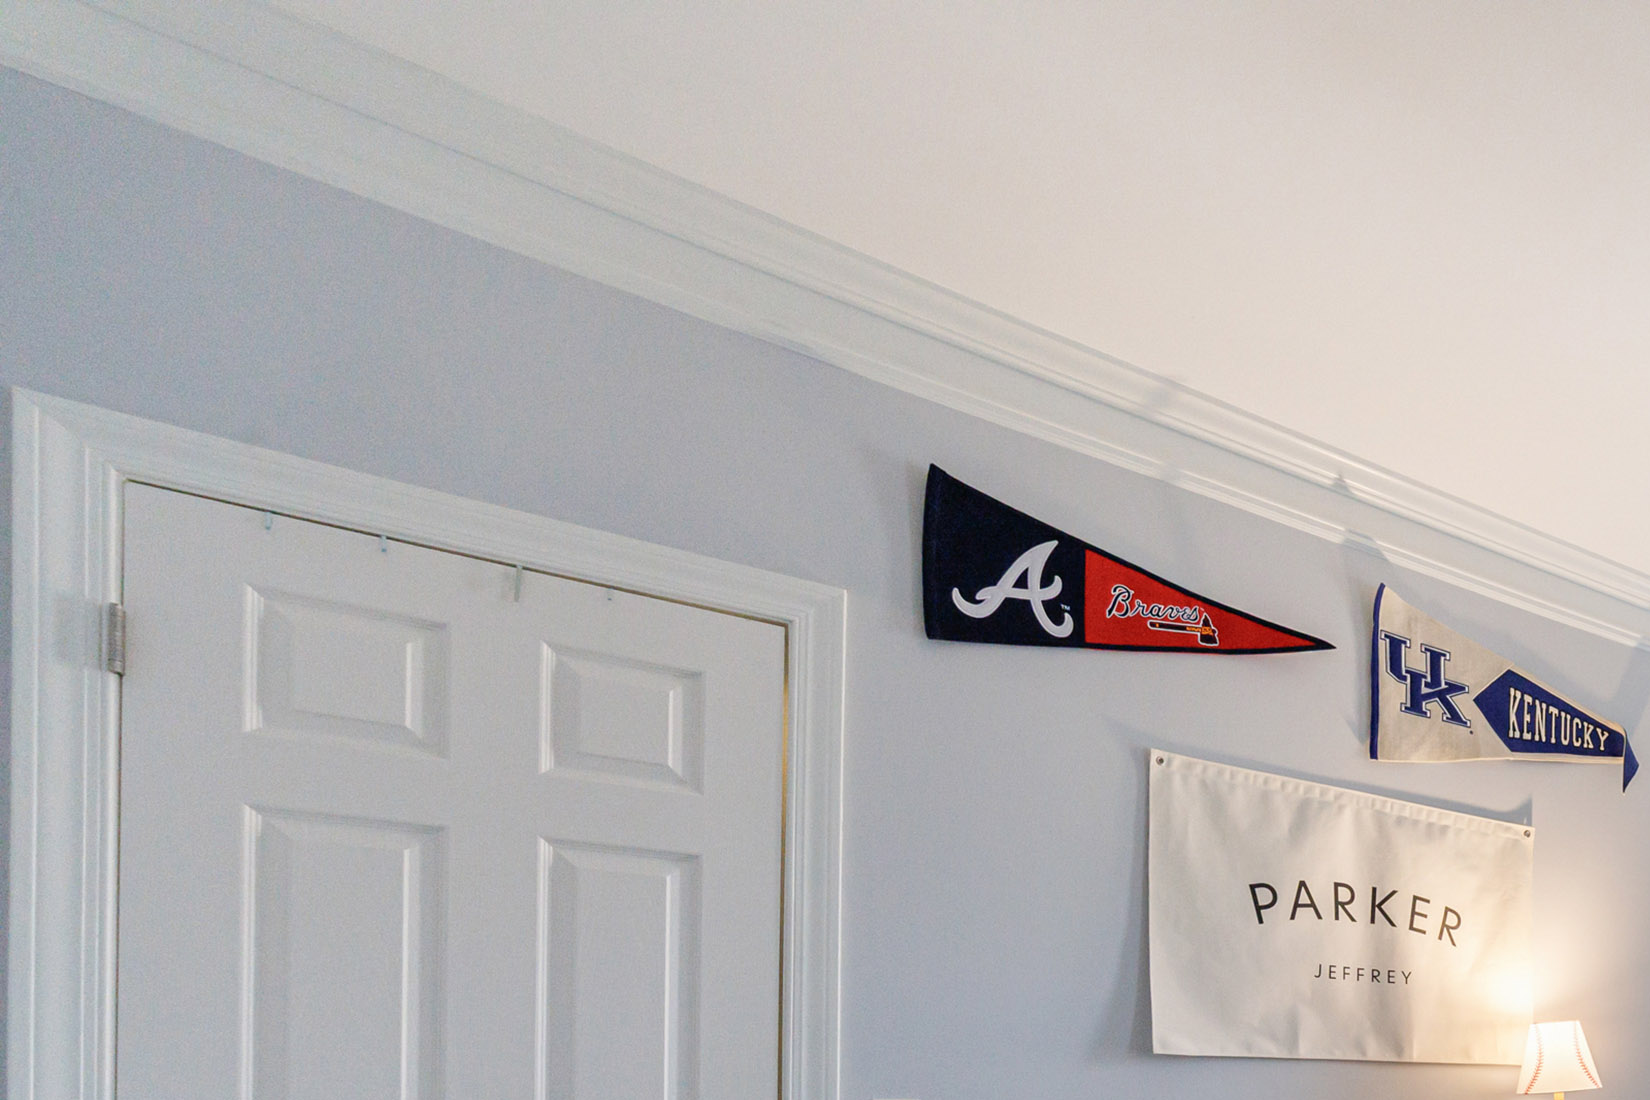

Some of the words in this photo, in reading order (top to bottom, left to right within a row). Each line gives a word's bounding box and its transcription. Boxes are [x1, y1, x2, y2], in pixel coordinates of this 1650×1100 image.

[951, 539, 1074, 638] A
[1106, 584, 1200, 623] Braves
[1380, 629, 1471, 728] UK
[1508, 686, 1609, 751] KENTUCKY
[1248, 879, 1462, 947] PARKER
[1314, 963, 1412, 985] JEFFREY
